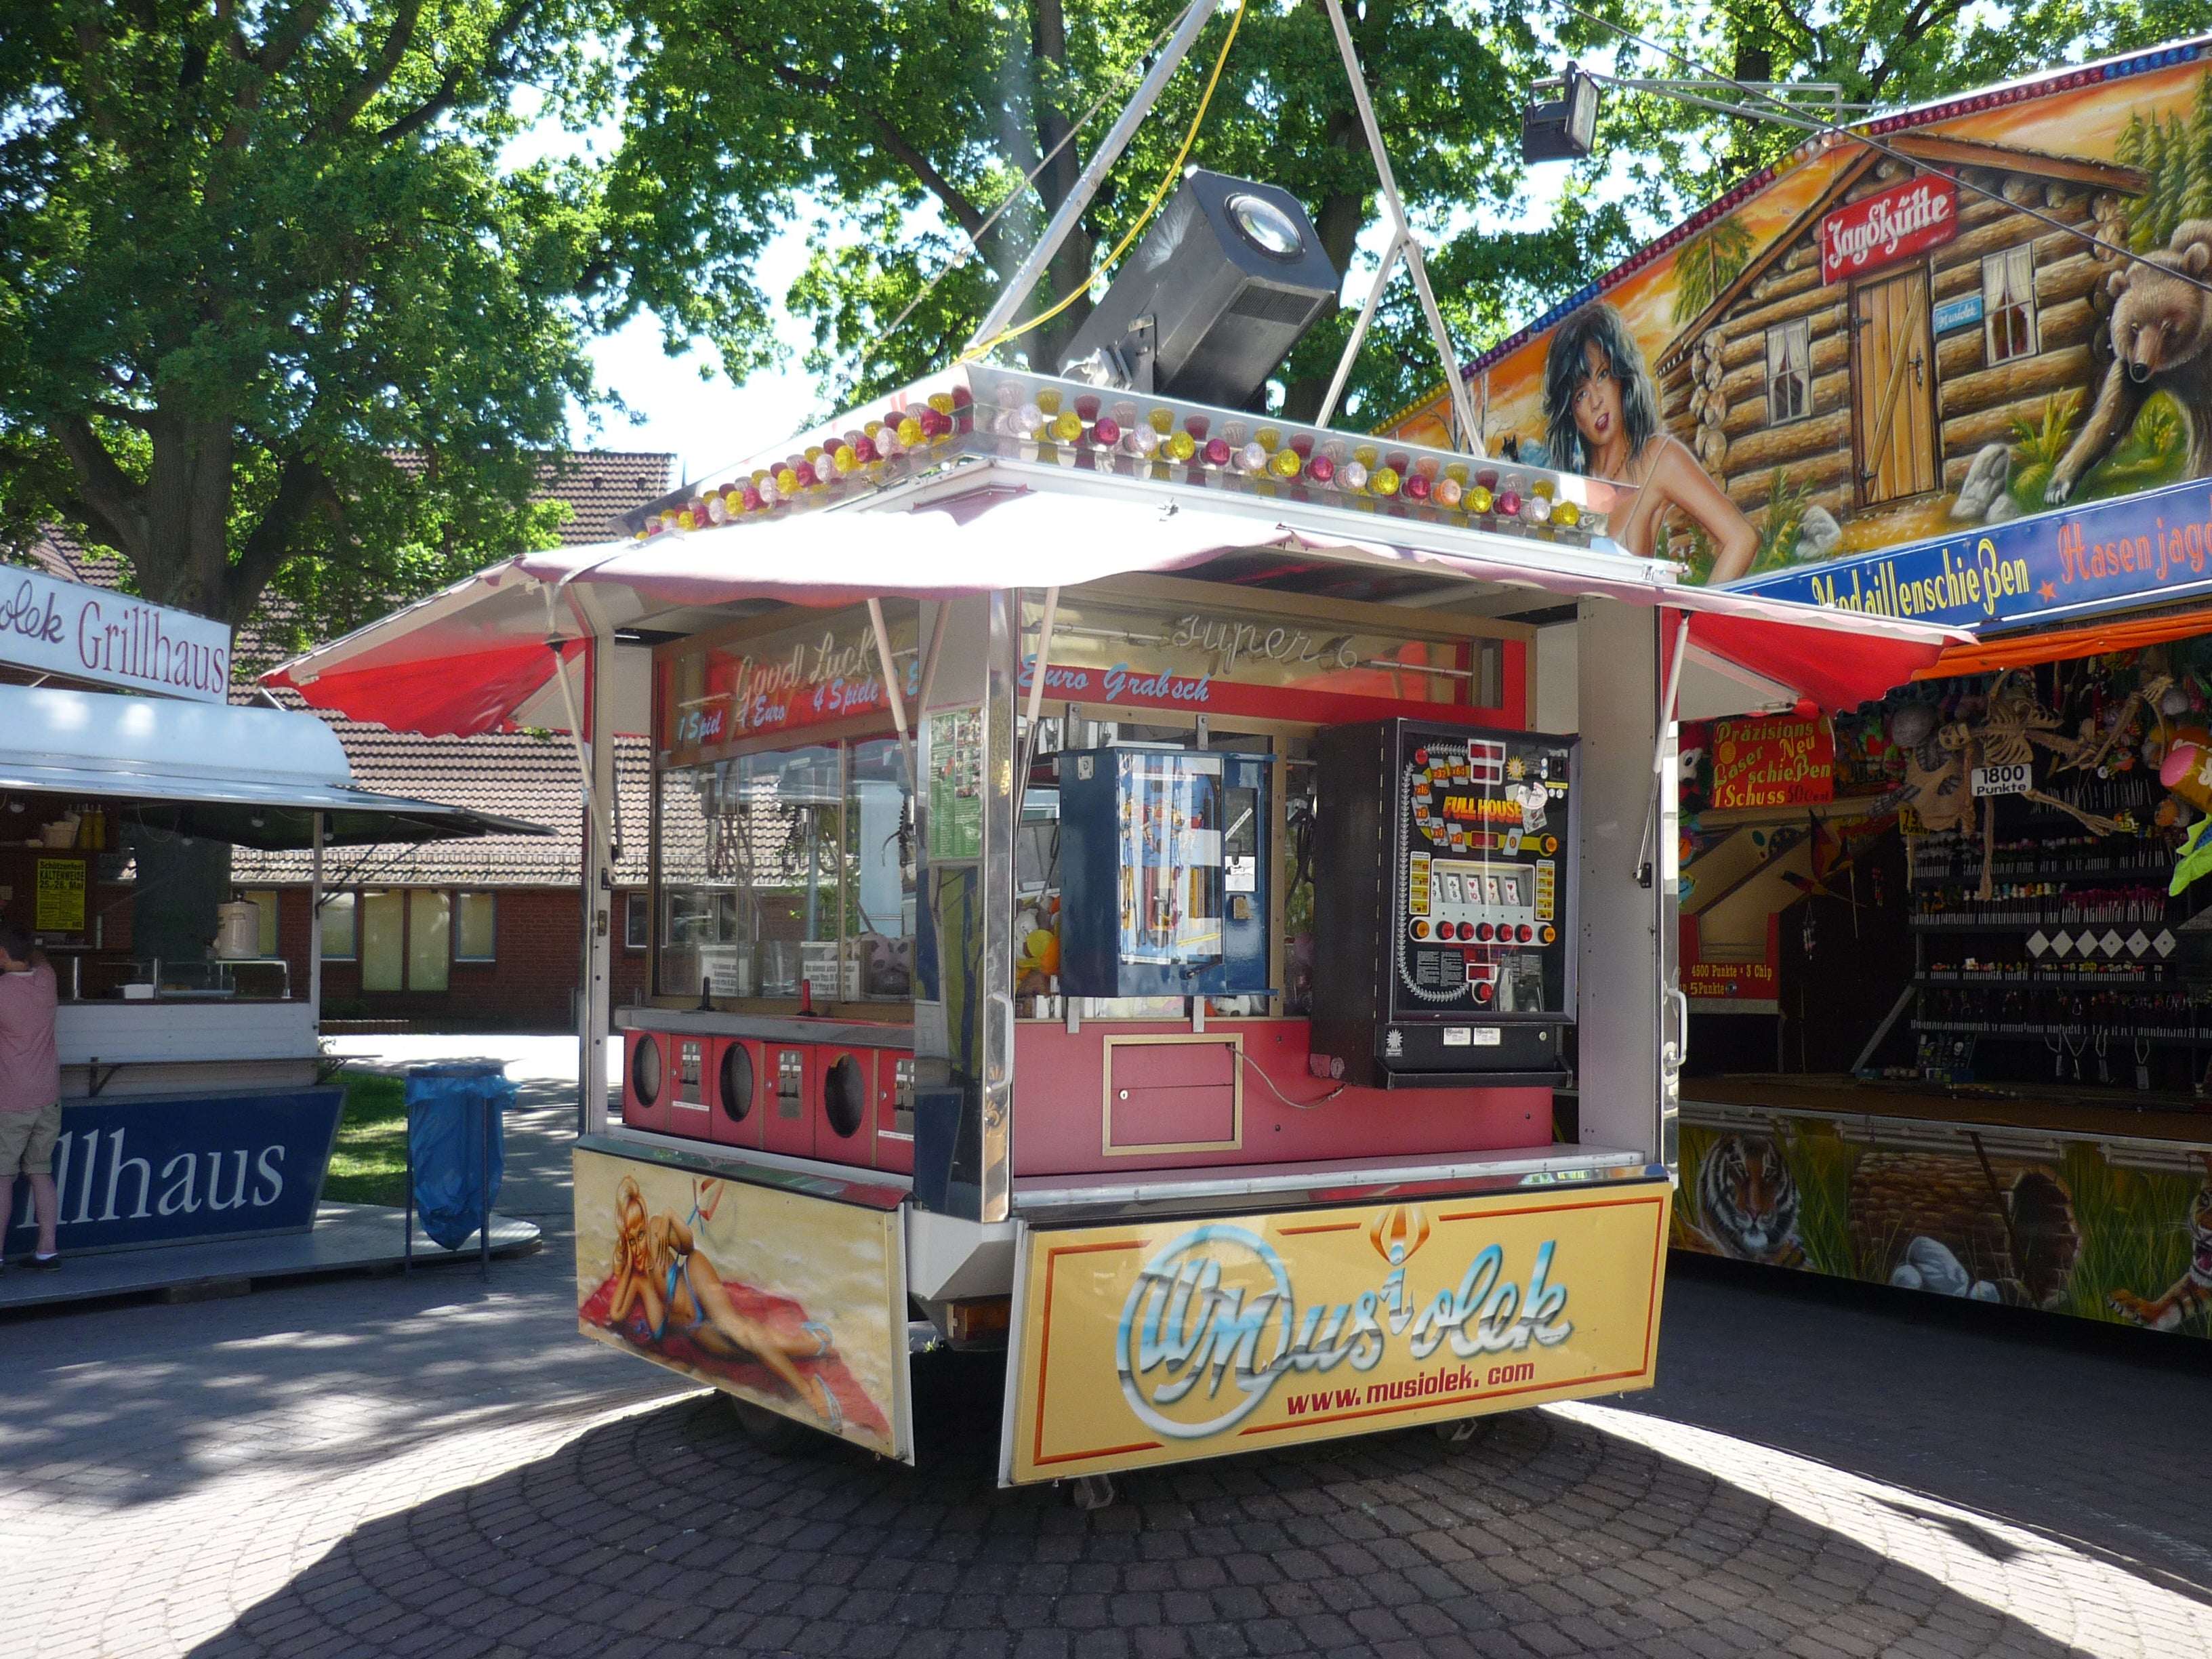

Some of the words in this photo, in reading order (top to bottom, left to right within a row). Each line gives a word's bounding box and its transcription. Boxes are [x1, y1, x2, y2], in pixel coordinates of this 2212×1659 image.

[1828, 186, 1949, 268] Jagdhütte
[78, 600, 226, 694] Grillhaus
[736, 644, 805, 702] Good
[1019, 654, 1088, 690] Euro
[1103, 663, 1210, 703] Grabsch
[678, 716, 687, 741] 1
[687, 711, 722, 744] Spiel
[753, 695, 786, 727] Euro
[813, 684, 824, 712] 4
[828, 675, 879, 714] Spiele
[1714, 720, 1814, 743] Präzisions
[1779, 735, 1816, 762] Neu
[1714, 746, 1763, 789] Laser
[1748, 754, 1831, 784] schießen
[1982, 765, 2025, 785] 1800
[1724, 781, 1785, 807] Schuss
[1804, 788, 1829, 802] Cent
[1977, 783, 2026, 795] Punkte
[1443, 796, 1477, 821] FULL
[1477, 798, 1523, 824] HOUSE
[1712, 964, 1737, 977] Punkte
[1755, 964, 1773, 981] Chip
[1698, 982, 1725, 994] Punkte
[16, 1127, 286, 1228] llhaus
